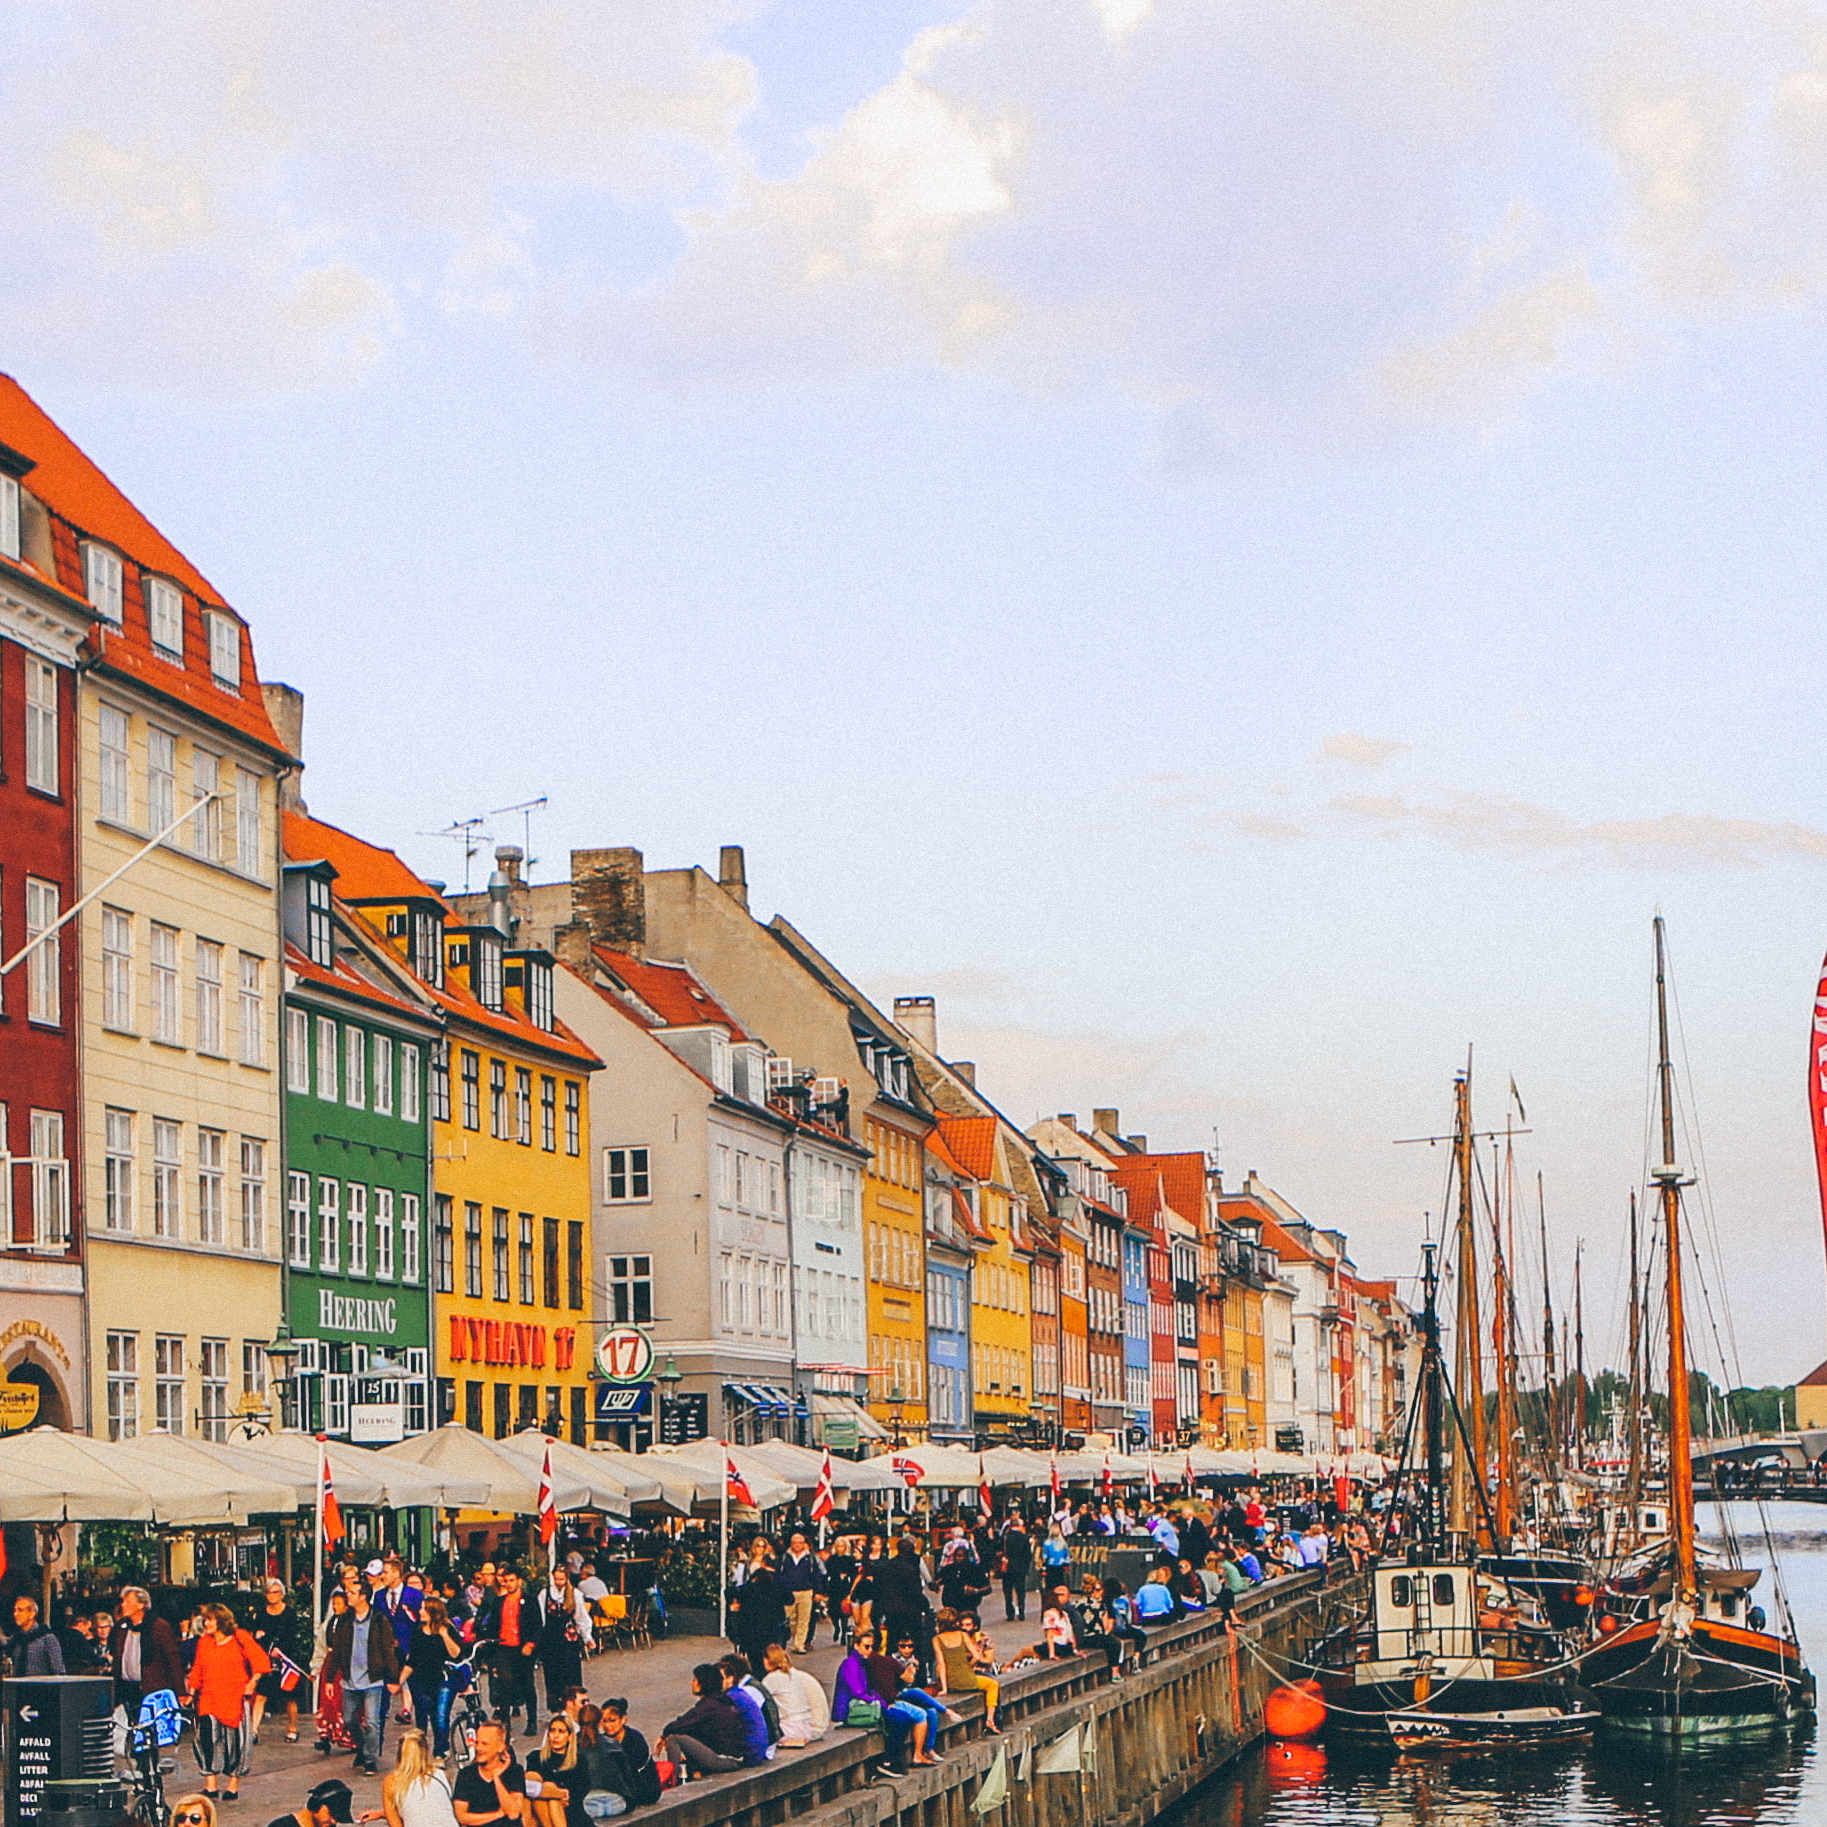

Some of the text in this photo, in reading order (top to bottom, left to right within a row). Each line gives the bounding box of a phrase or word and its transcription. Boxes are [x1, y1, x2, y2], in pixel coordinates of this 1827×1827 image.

[318, 1289, 398, 1335] HEERING
[450, 1314, 546, 1369] NYHAVN
[602, 1336, 640, 1376] 17
[358, 1416, 397, 1426] HEERING
[1179, 1431, 1190, 1441] 37
[19, 1738, 51, 1747] AFFALD
[19, 1752, 51, 1761] AVFALL
[19, 1766, 49, 1775] LITTER
